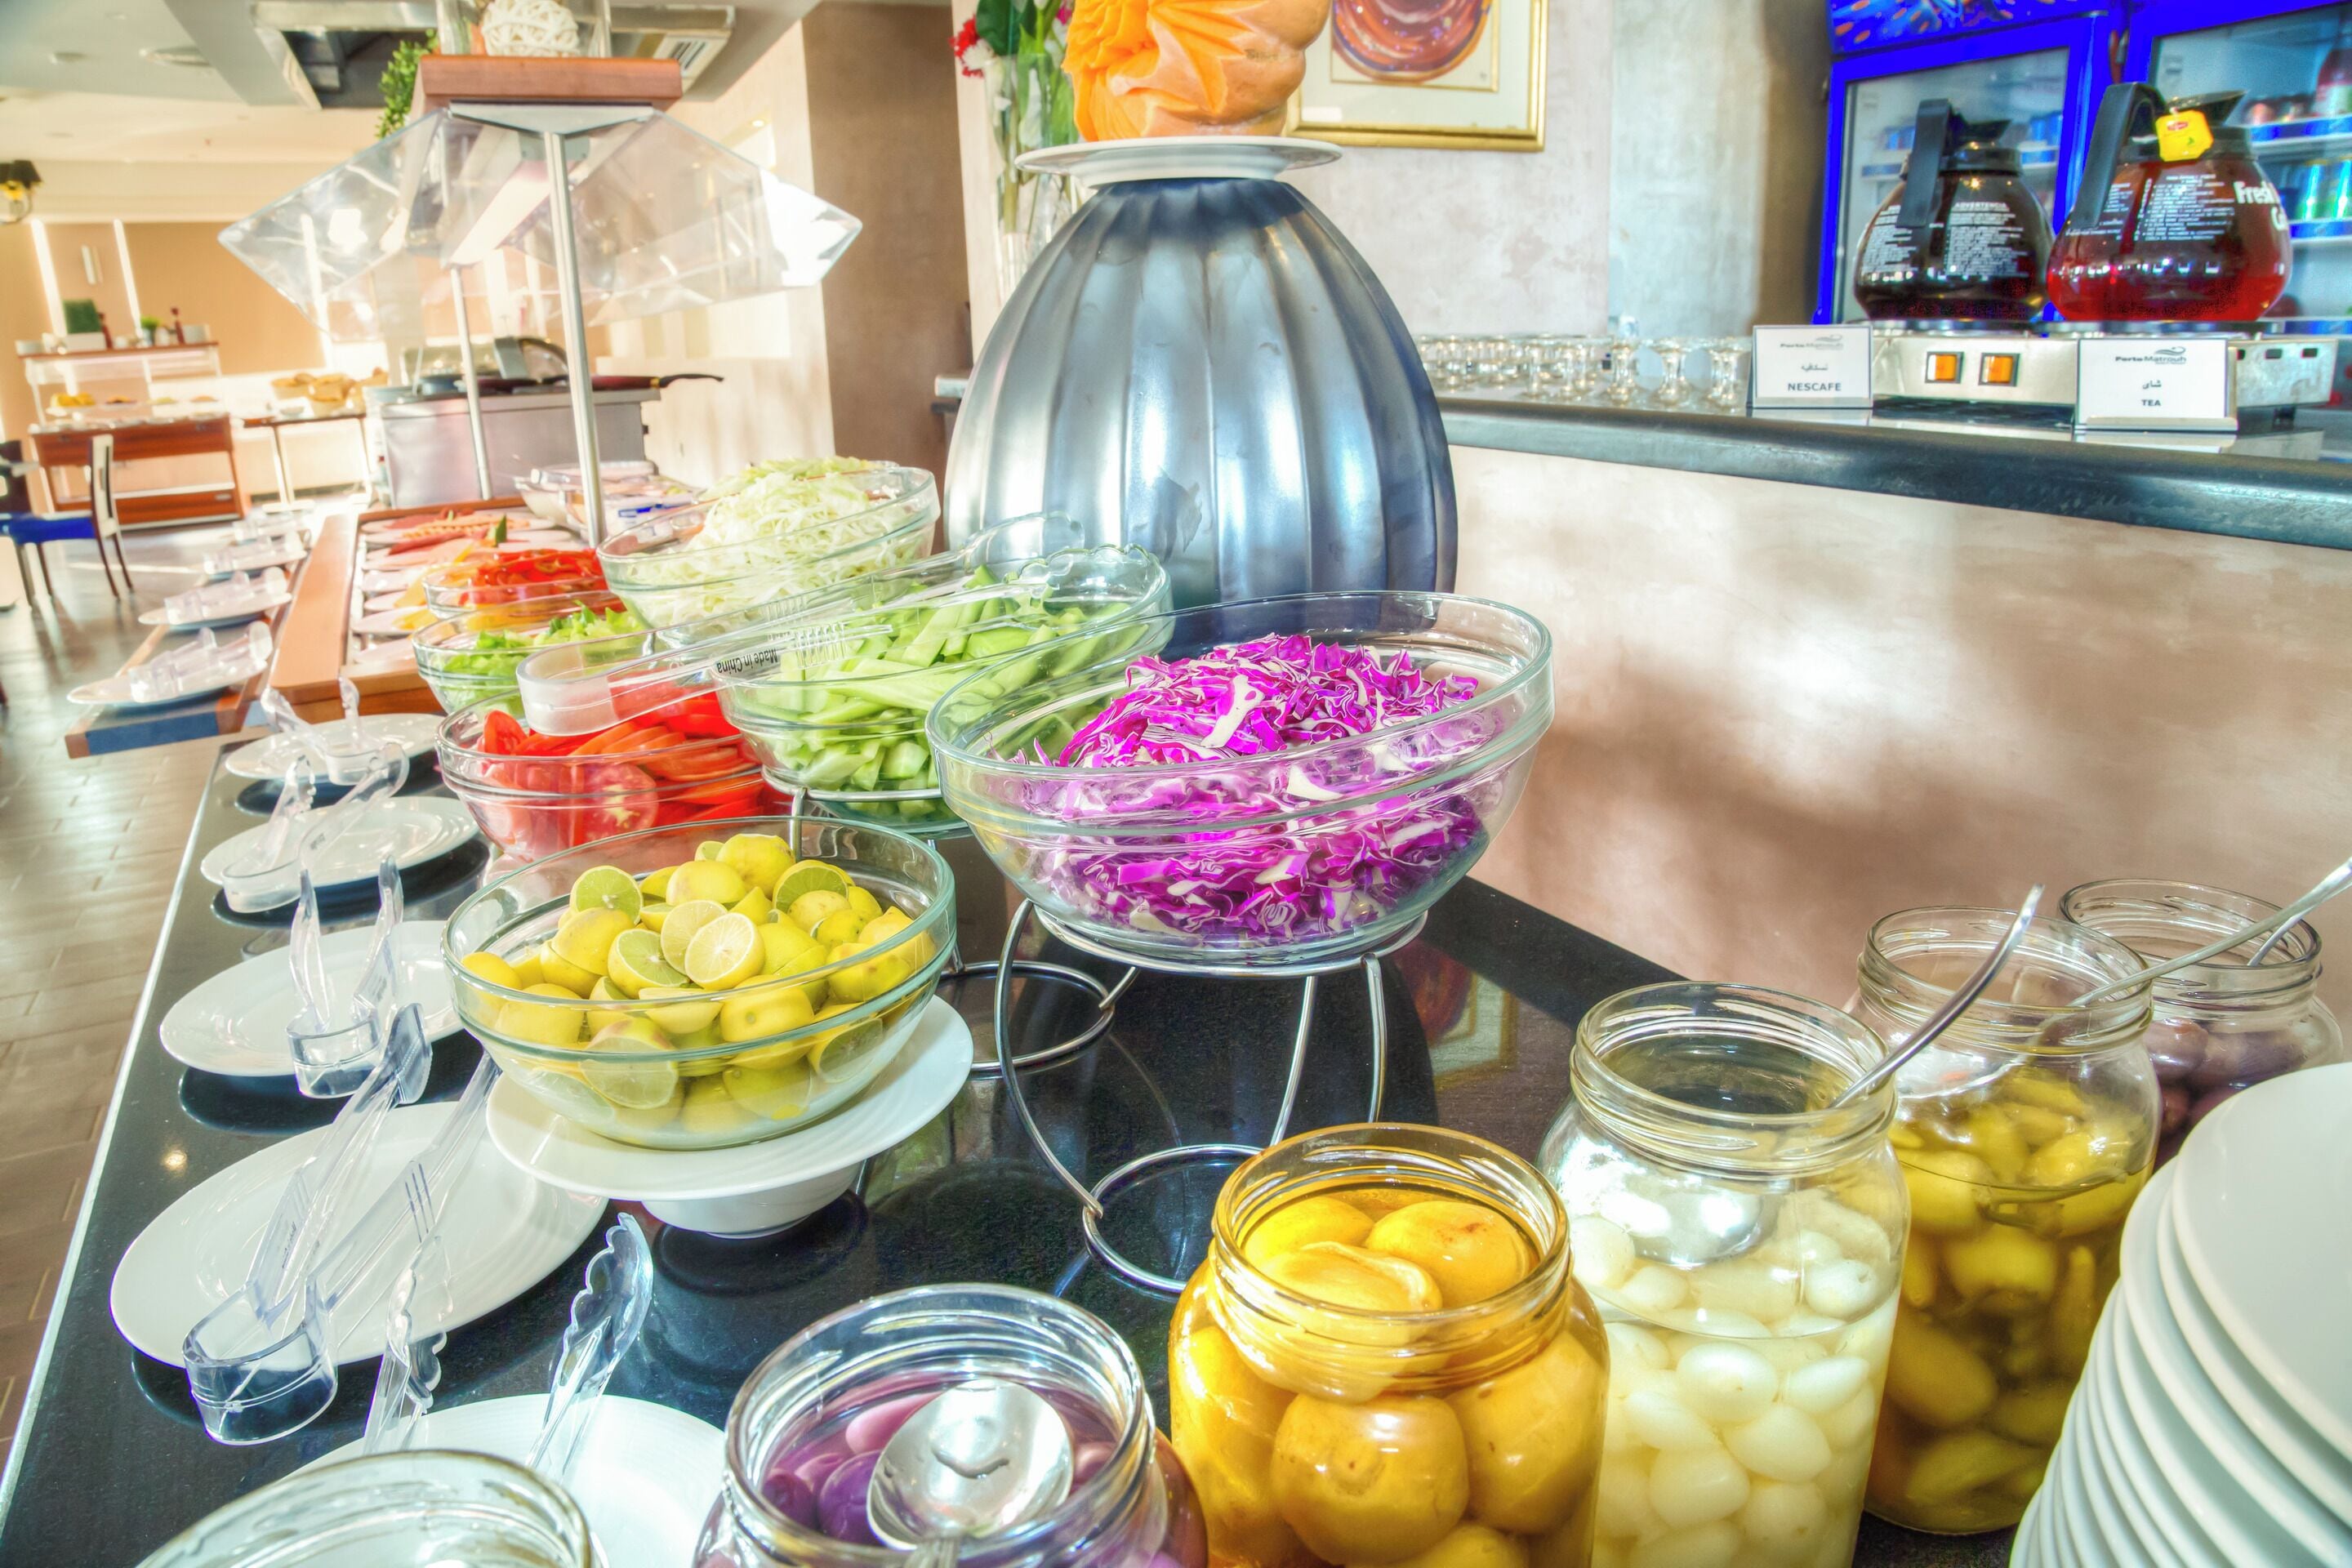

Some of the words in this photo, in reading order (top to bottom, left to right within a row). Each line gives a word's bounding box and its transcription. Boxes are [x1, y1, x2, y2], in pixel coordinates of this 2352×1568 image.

[1787, 382, 1842, 392] NESCAFE
[2141, 399, 2162, 407] TEA
[744, 654, 754, 669] in
[754, 648, 778, 666] Made
[716, 657, 743, 675] China
